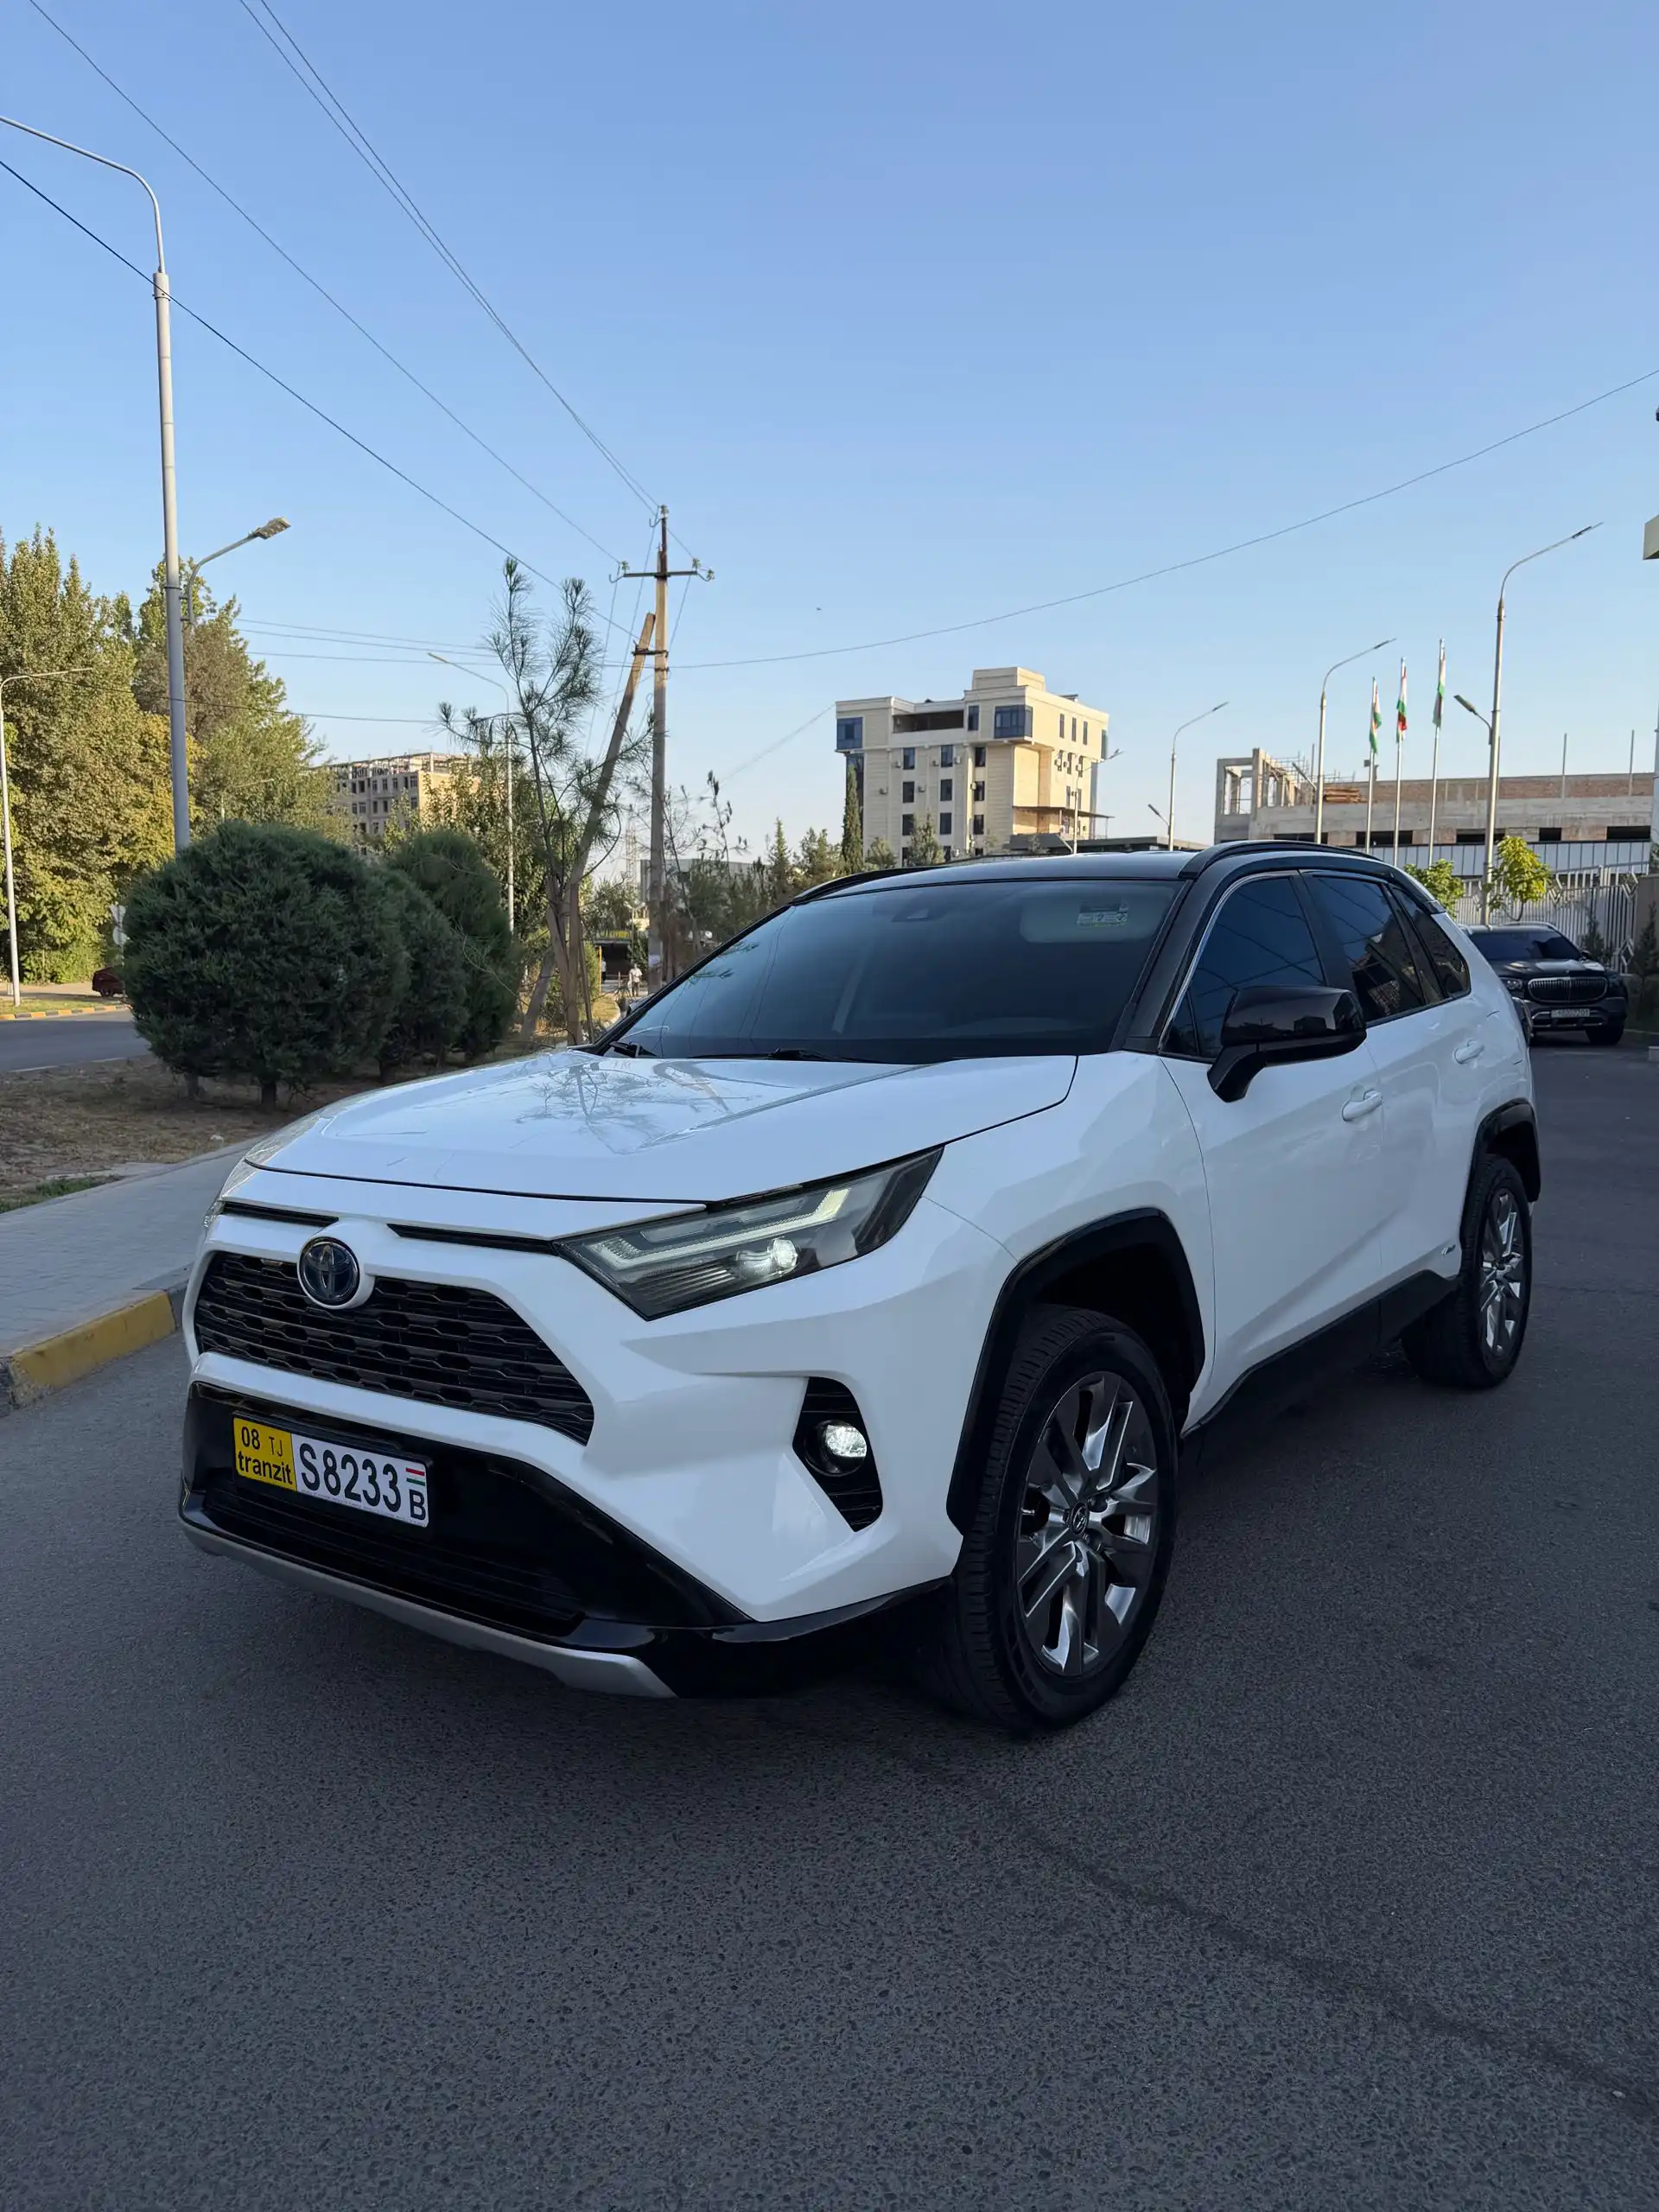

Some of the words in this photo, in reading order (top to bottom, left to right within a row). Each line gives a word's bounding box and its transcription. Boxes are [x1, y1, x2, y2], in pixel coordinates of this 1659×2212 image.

[241, 1426, 261, 1450] 08
[269, 1436, 283, 1457] TJ
[238, 1452, 293, 1485] tranzit
[299, 1443, 402, 1513] S8233
[409, 1489, 427, 1521] B
